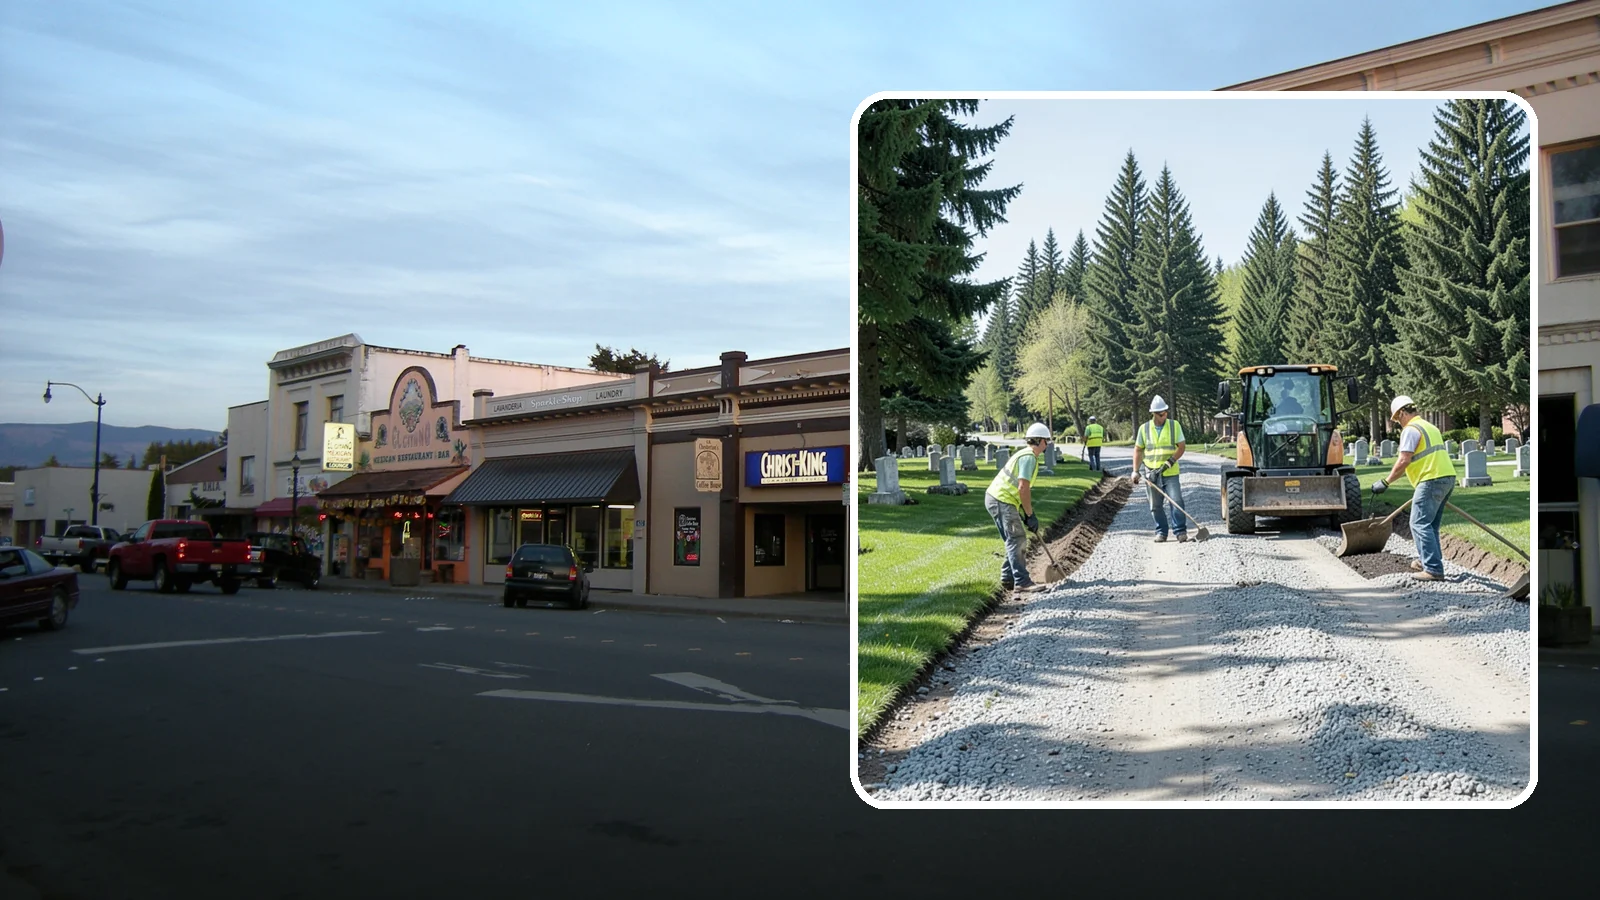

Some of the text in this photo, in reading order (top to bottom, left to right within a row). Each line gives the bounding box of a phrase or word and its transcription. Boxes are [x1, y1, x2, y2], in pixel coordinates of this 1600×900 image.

[493, 401, 523, 413] LAVANDERIA
[561, 394, 583, 405] Shop
[595, 389, 624, 400] LAUNDRY
[374, 454, 396, 464] MEXICAN
[397, 451, 433, 462] RESTAURANT
[438, 450, 450, 459] BAR
[760, 450, 827, 478] CHRIST KING
[710, 481, 722, 489] House
